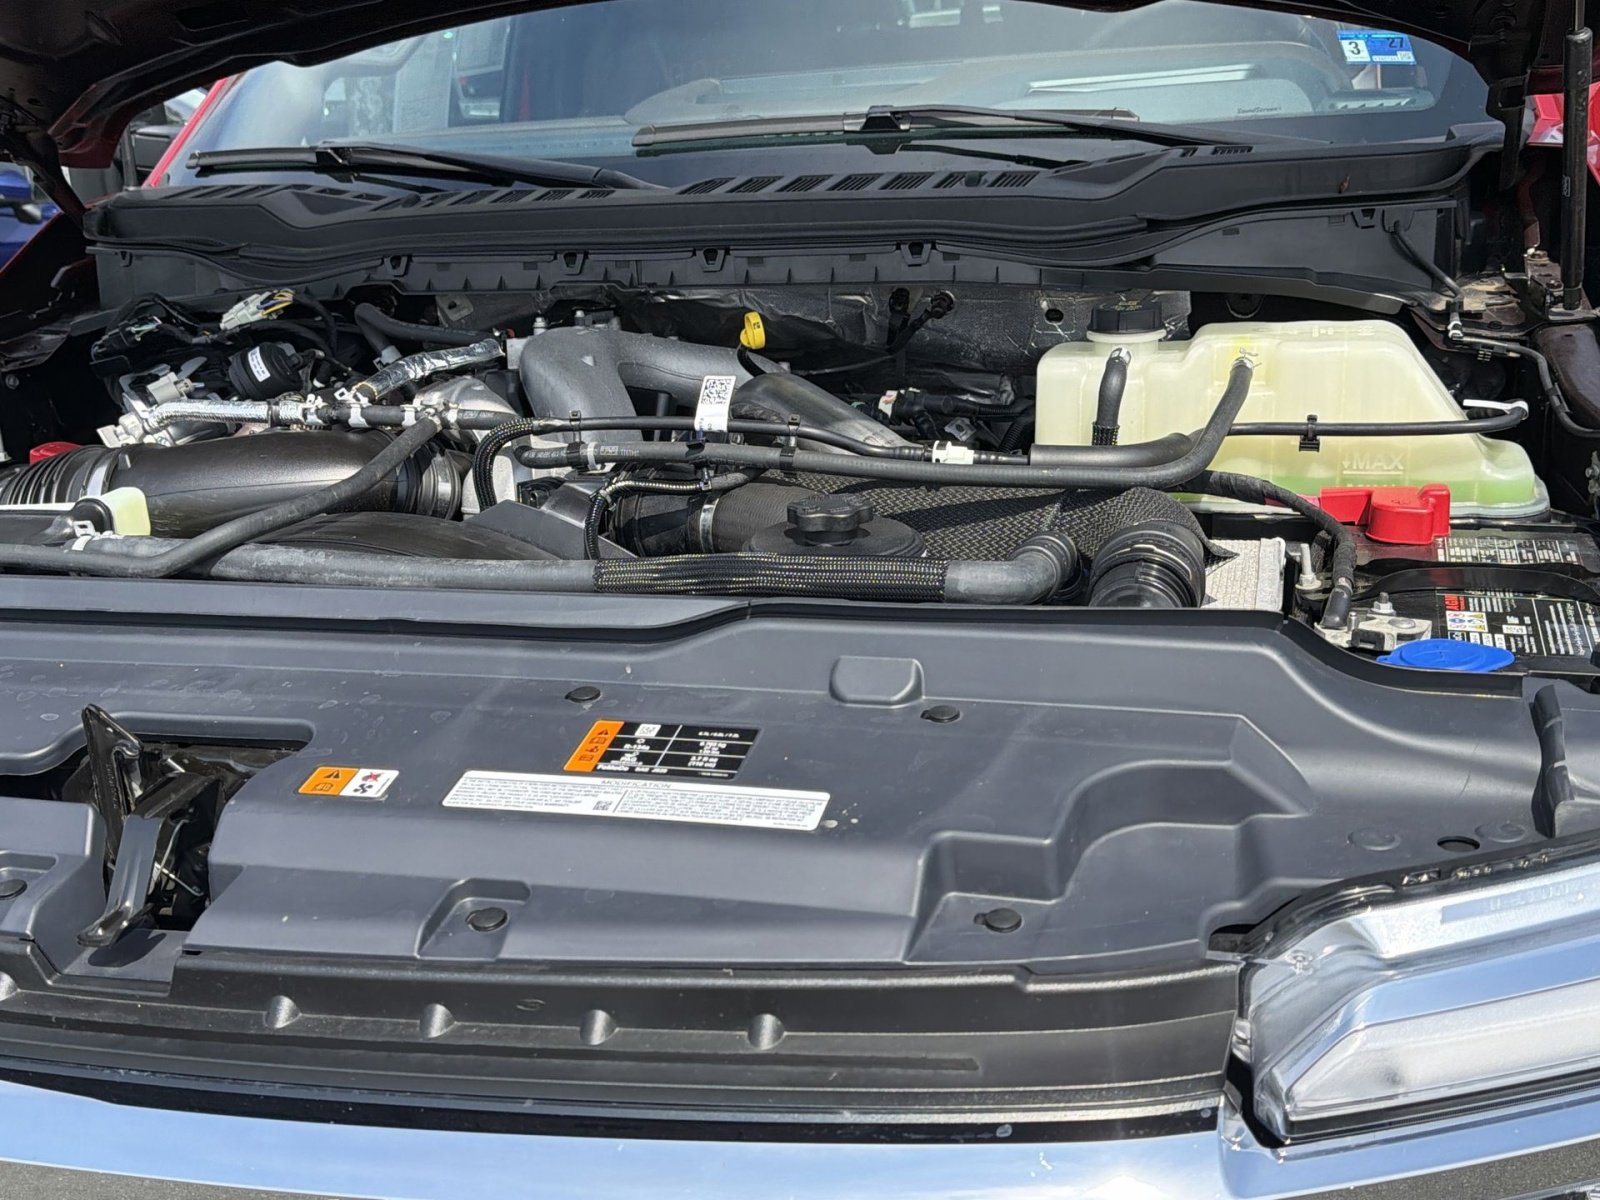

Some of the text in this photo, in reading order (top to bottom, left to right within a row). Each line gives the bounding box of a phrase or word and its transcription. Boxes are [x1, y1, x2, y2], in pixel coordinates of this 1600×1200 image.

[1348, 40, 1361, 55] 3
[1387, 37, 1404, 49] 27
[1352, 453, 1404, 470] MAX
[601, 779, 672, 789] MODIFICATION
